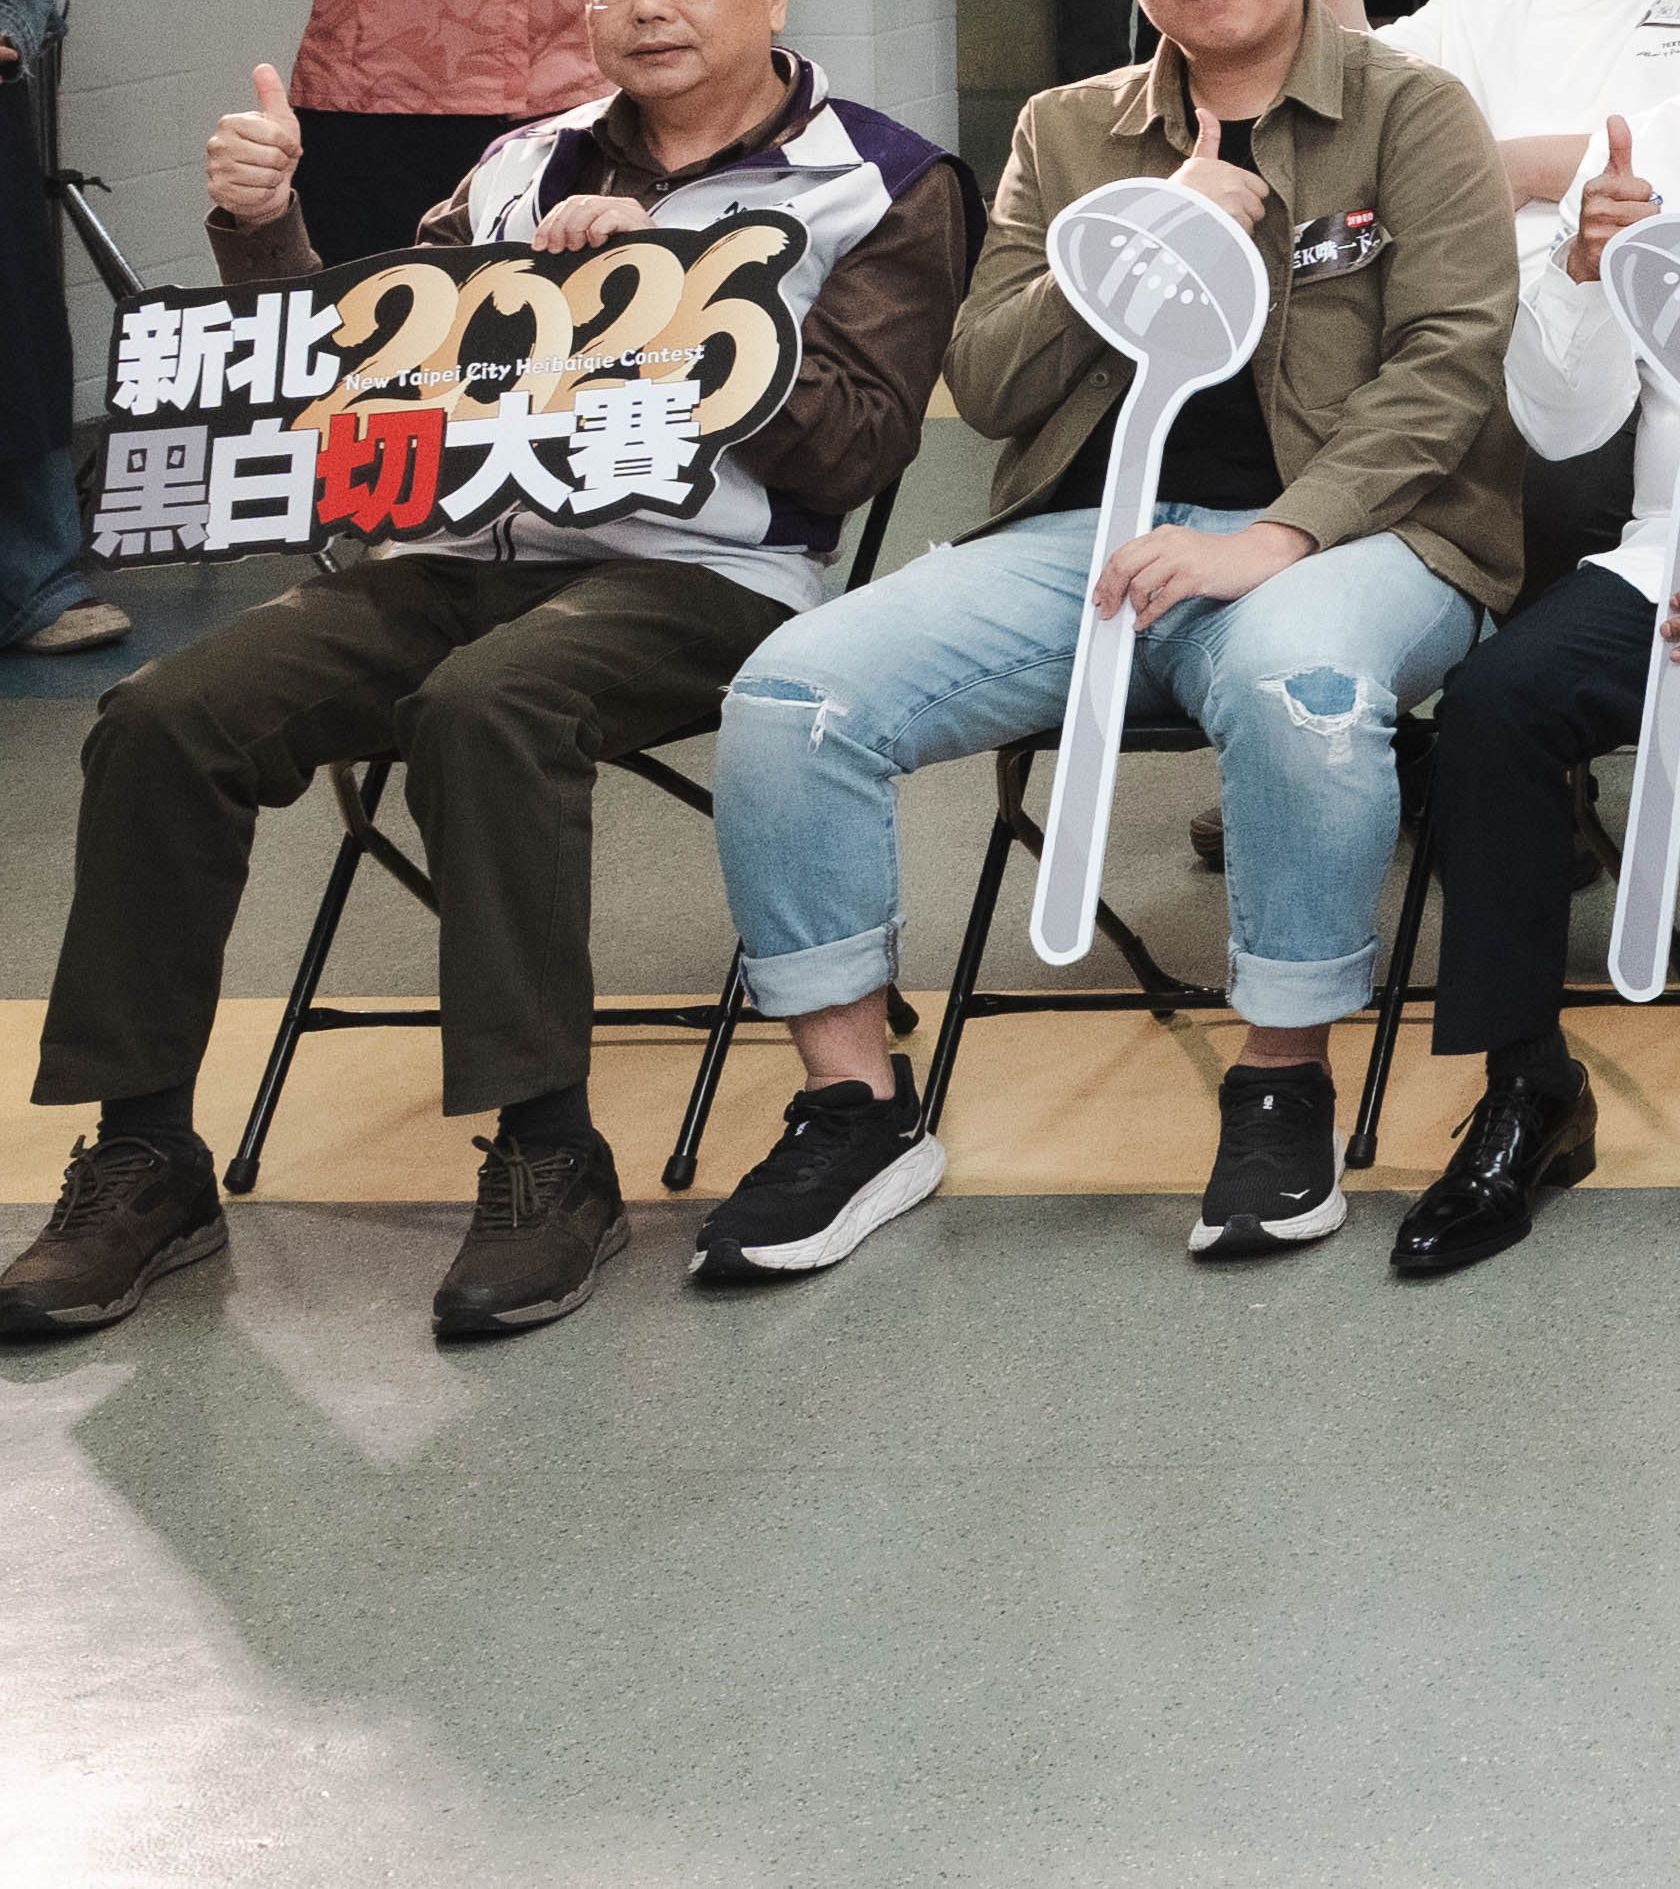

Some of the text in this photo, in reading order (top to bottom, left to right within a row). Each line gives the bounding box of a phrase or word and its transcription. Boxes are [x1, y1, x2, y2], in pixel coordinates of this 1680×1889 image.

[112, 223, 790, 440] 新北 2026
[345, 343, 706, 393] New Taipei City Heibaiqie Contest
[91, 378, 704, 561] 黑白切大賽
